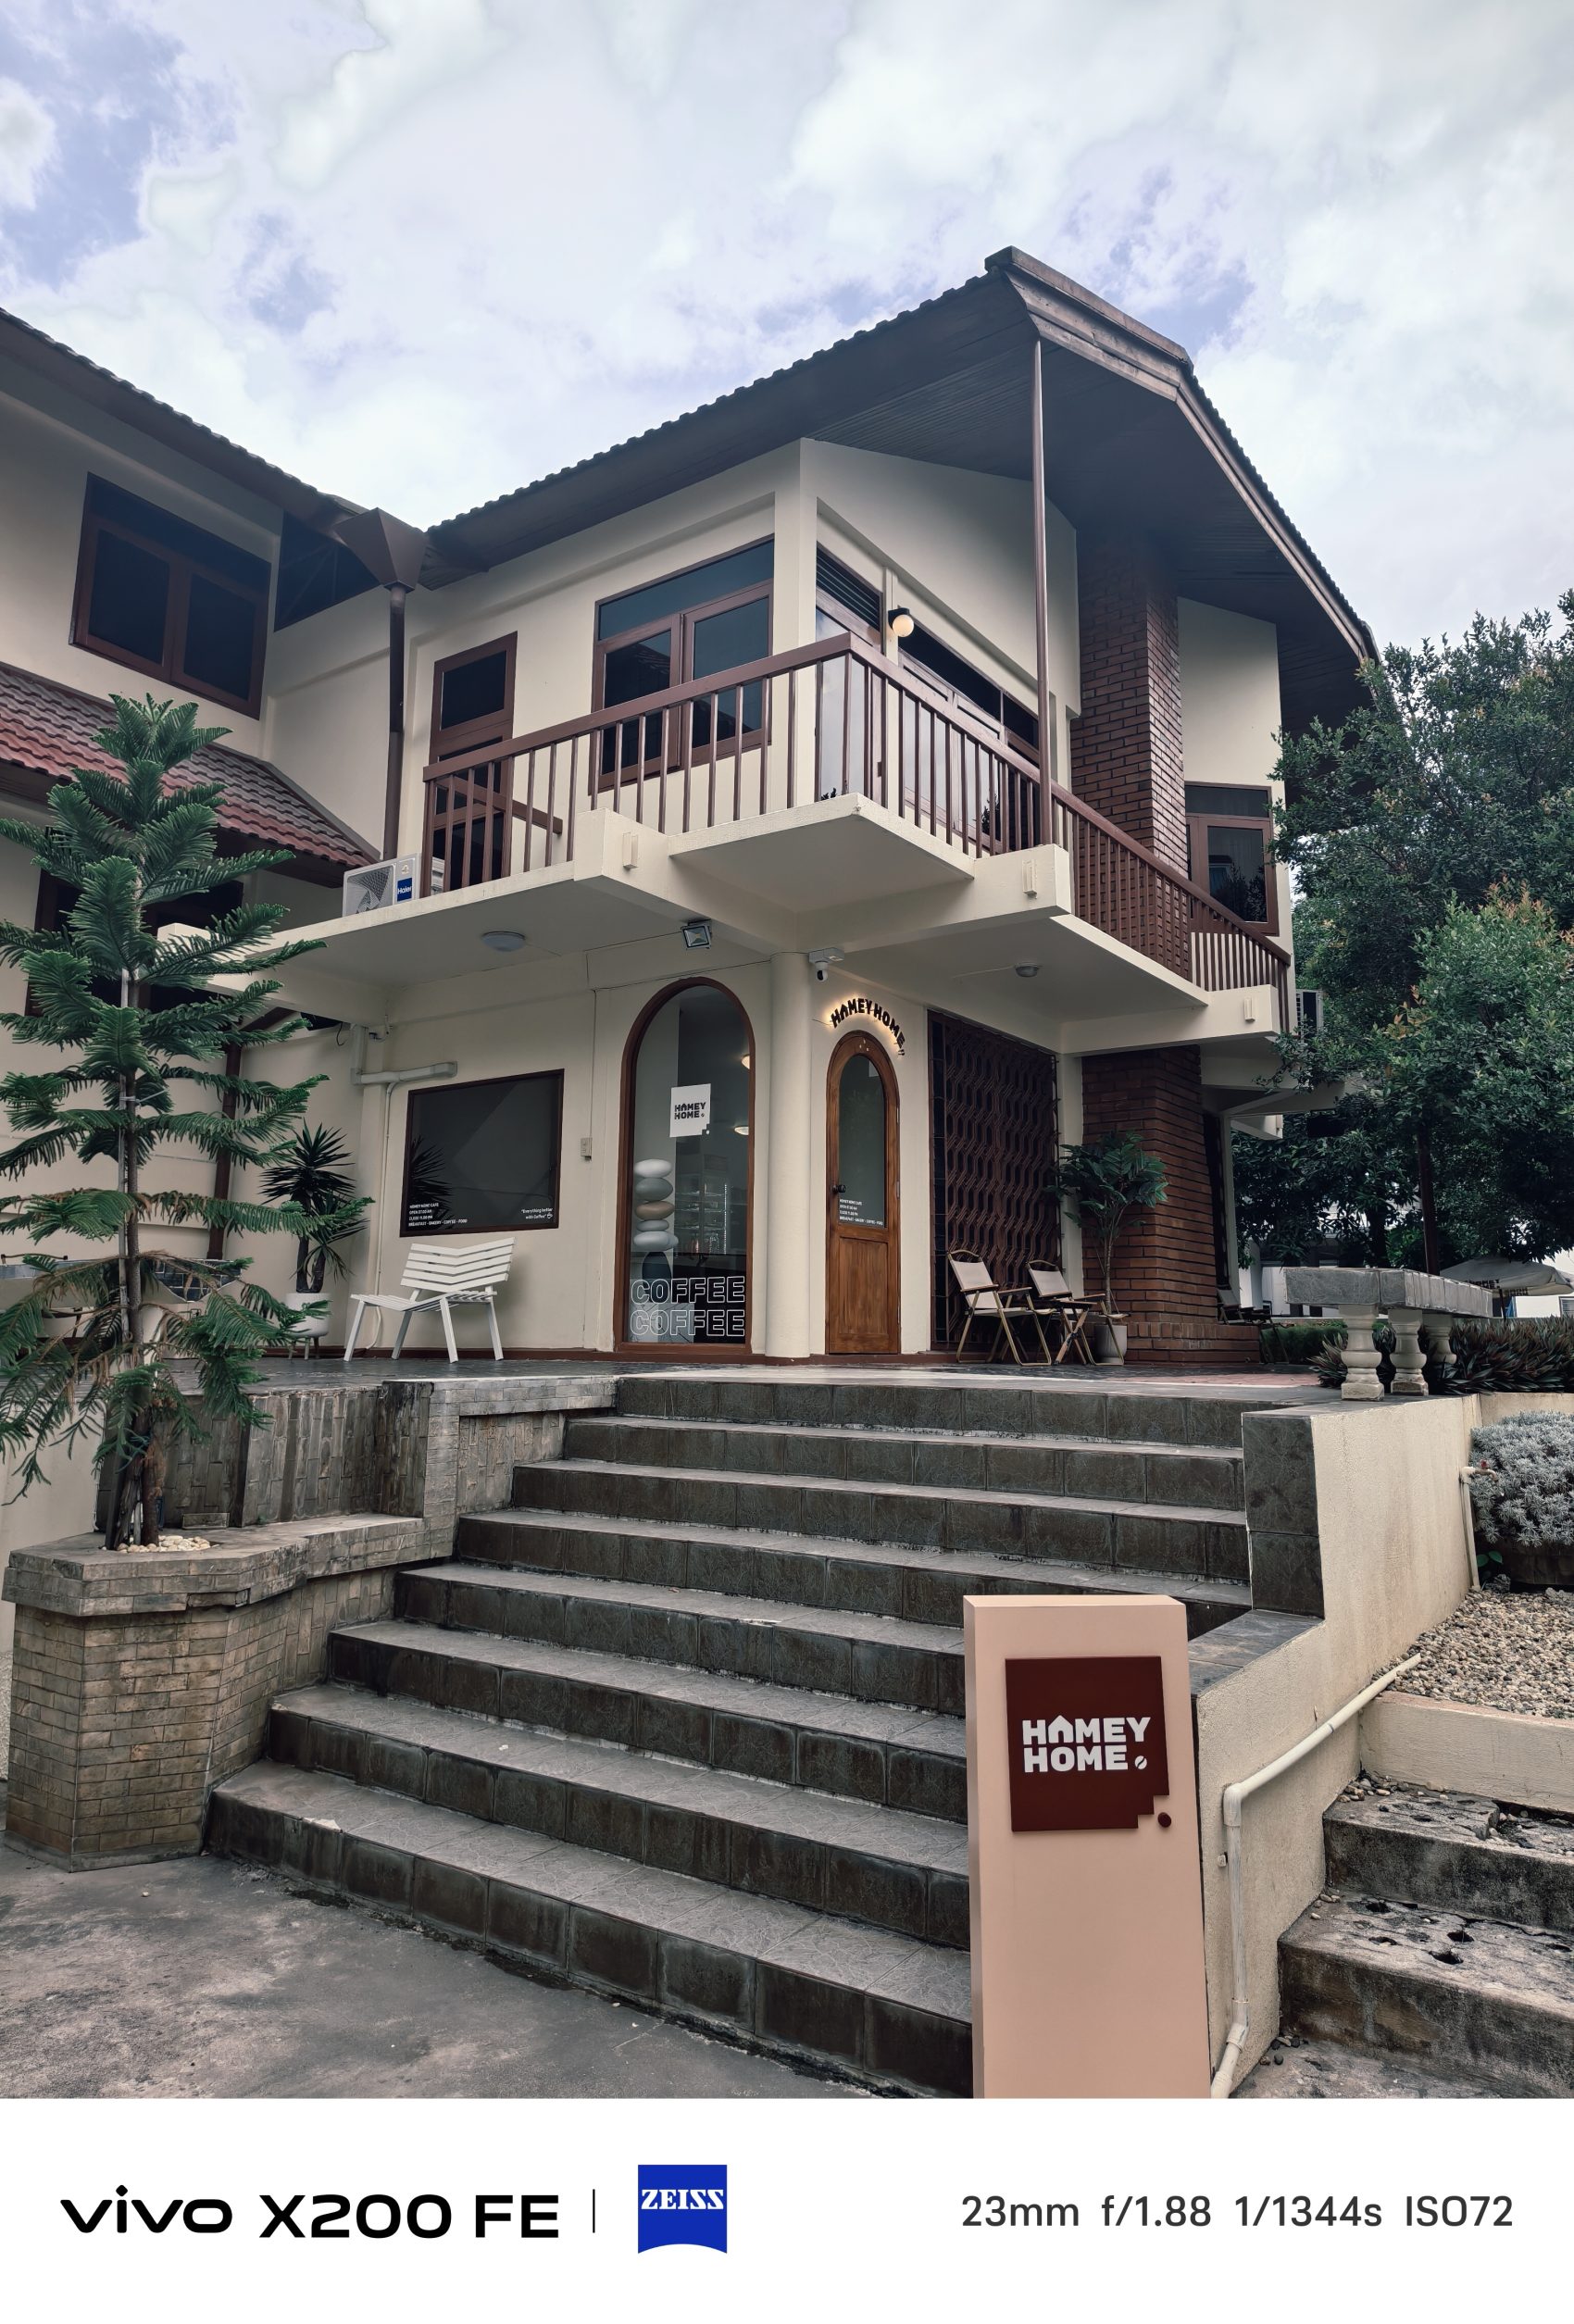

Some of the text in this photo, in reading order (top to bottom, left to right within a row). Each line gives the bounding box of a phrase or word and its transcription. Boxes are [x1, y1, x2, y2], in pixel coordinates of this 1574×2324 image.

[397, 886, 412, 894] Haier
[873, 1003, 906, 1049] HOME
[631, 1276, 745, 1306] COFFEE
[631, 1309, 745, 1337] COFFEE
[1024, 1744, 1128, 1772] HOME
